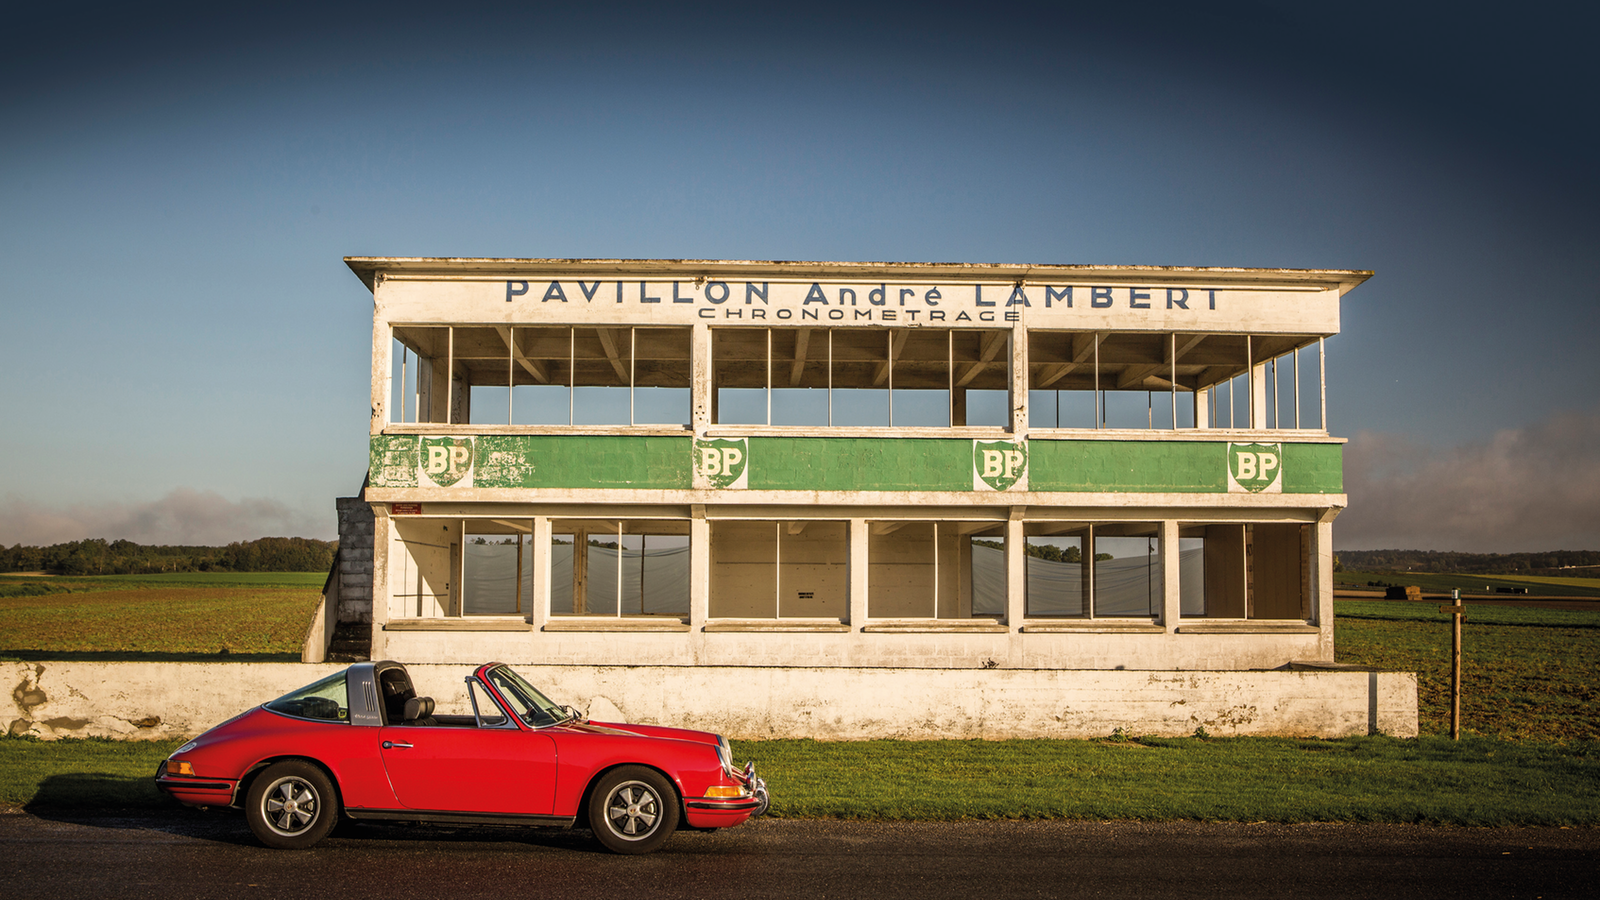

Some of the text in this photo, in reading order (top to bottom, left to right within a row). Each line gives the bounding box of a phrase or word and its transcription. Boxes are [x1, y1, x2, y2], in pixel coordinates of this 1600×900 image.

[505, 280, 1223, 310] PAVILLON André LAMBERT
[698, 308, 1020, 322] CHRONOMETRAGE
[427, 445, 469, 474] BP
[700, 447, 742, 476] BP
[981, 449, 1024, 479] BP
[1236, 451, 1278, 481] BP
